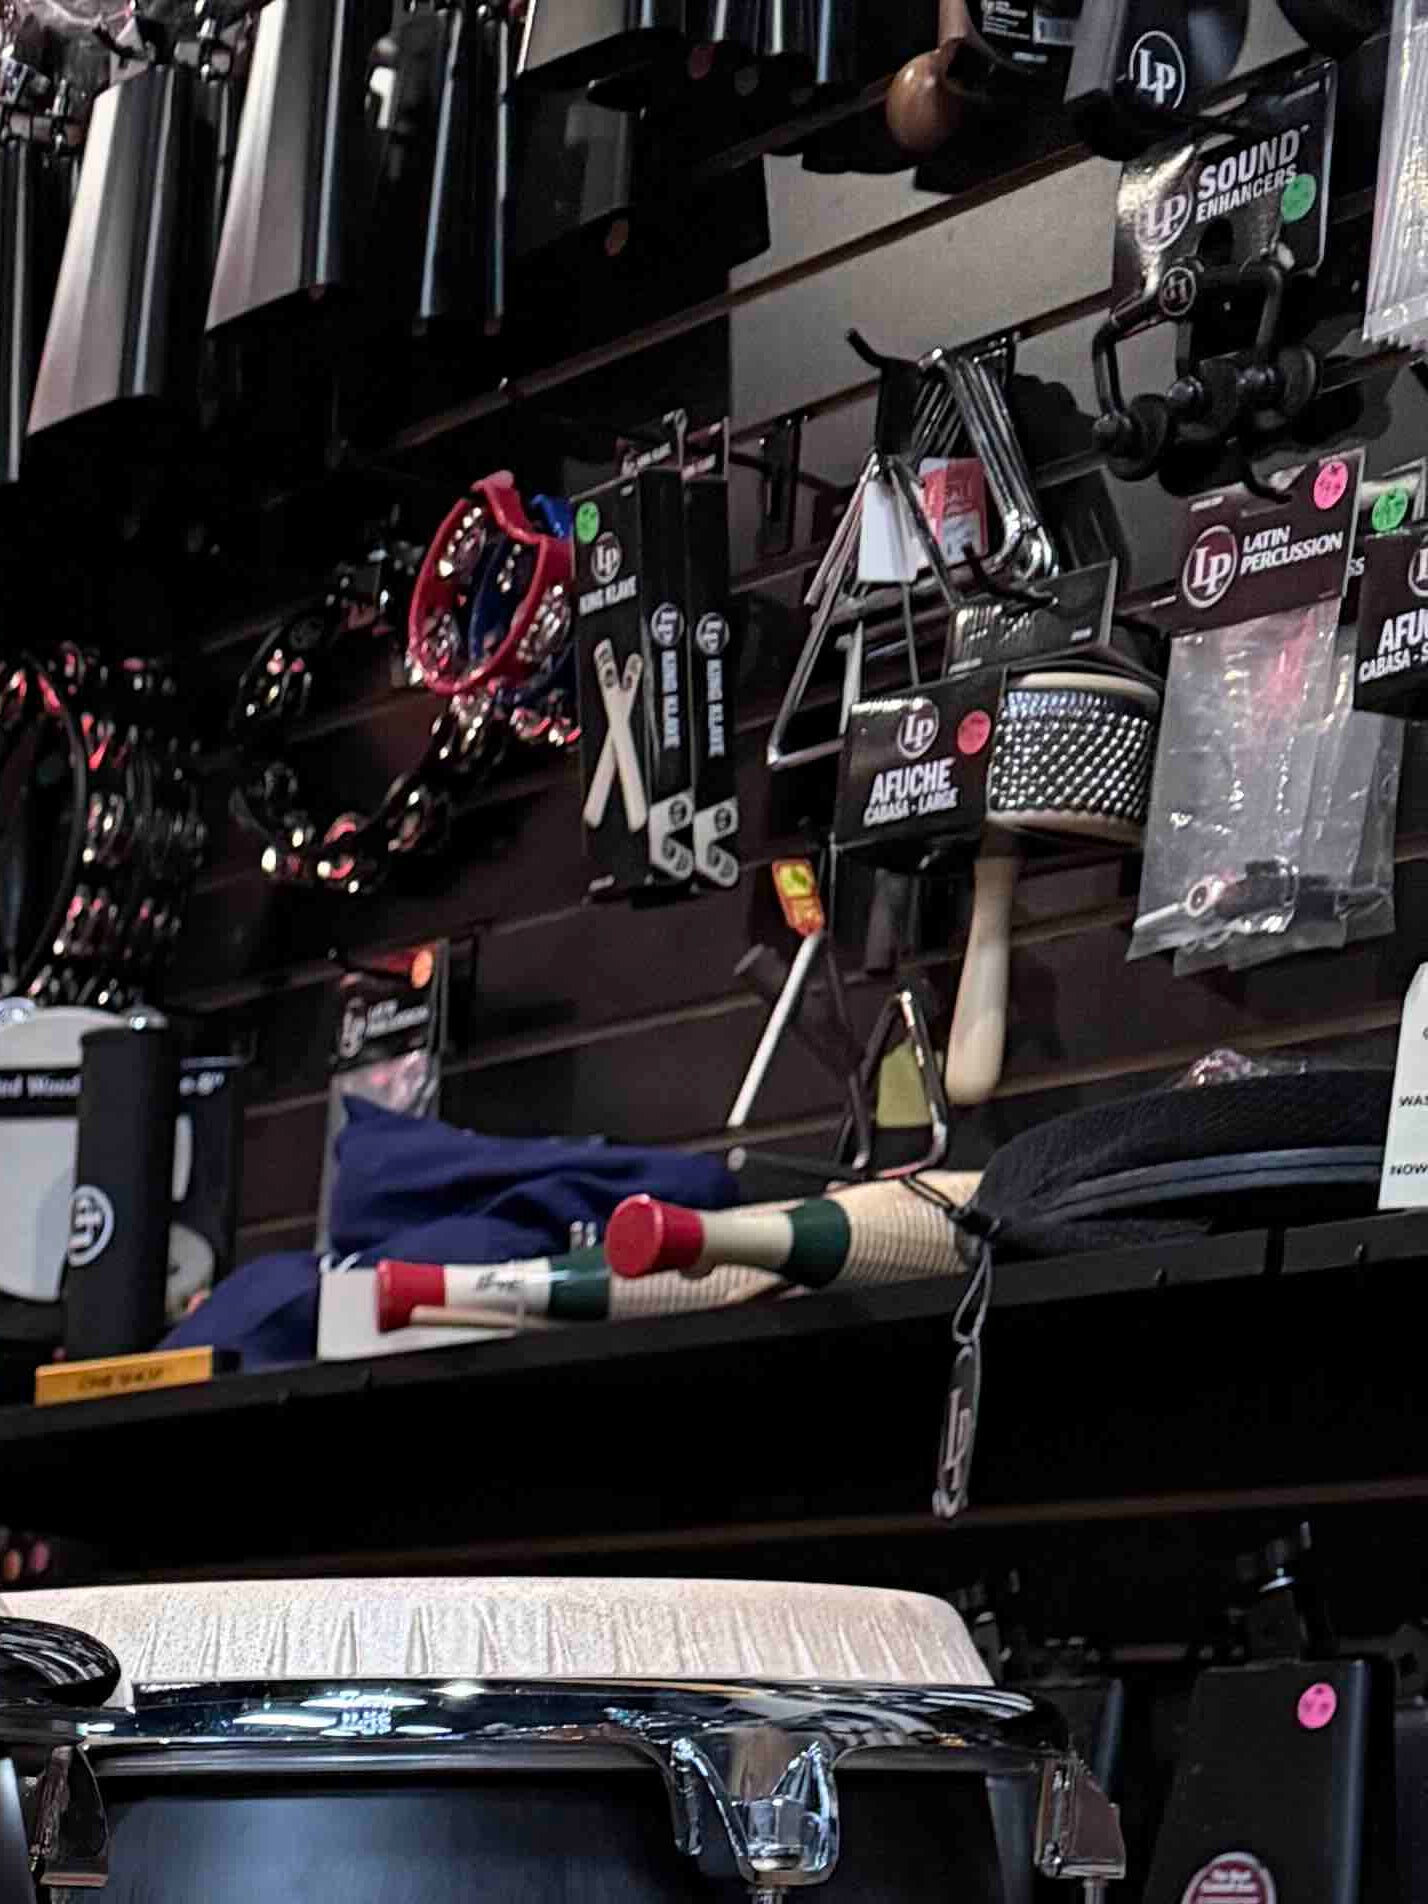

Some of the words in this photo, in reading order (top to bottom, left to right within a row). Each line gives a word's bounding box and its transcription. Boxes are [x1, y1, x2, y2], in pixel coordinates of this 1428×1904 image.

[1135, 46, 1176, 104] LP
[1197, 128, 1301, 200] SOUND
[1195, 163, 1298, 225] ENHANCERS
[1240, 532, 1344, 576] PERCUSSION
[1243, 525, 1292, 552] LATIN
[1191, 546, 1232, 597] LP
[1358, 648, 1411, 684] CABASA
[904, 713, 935, 749] LP
[869, 757, 957, 806] AFUCHE
